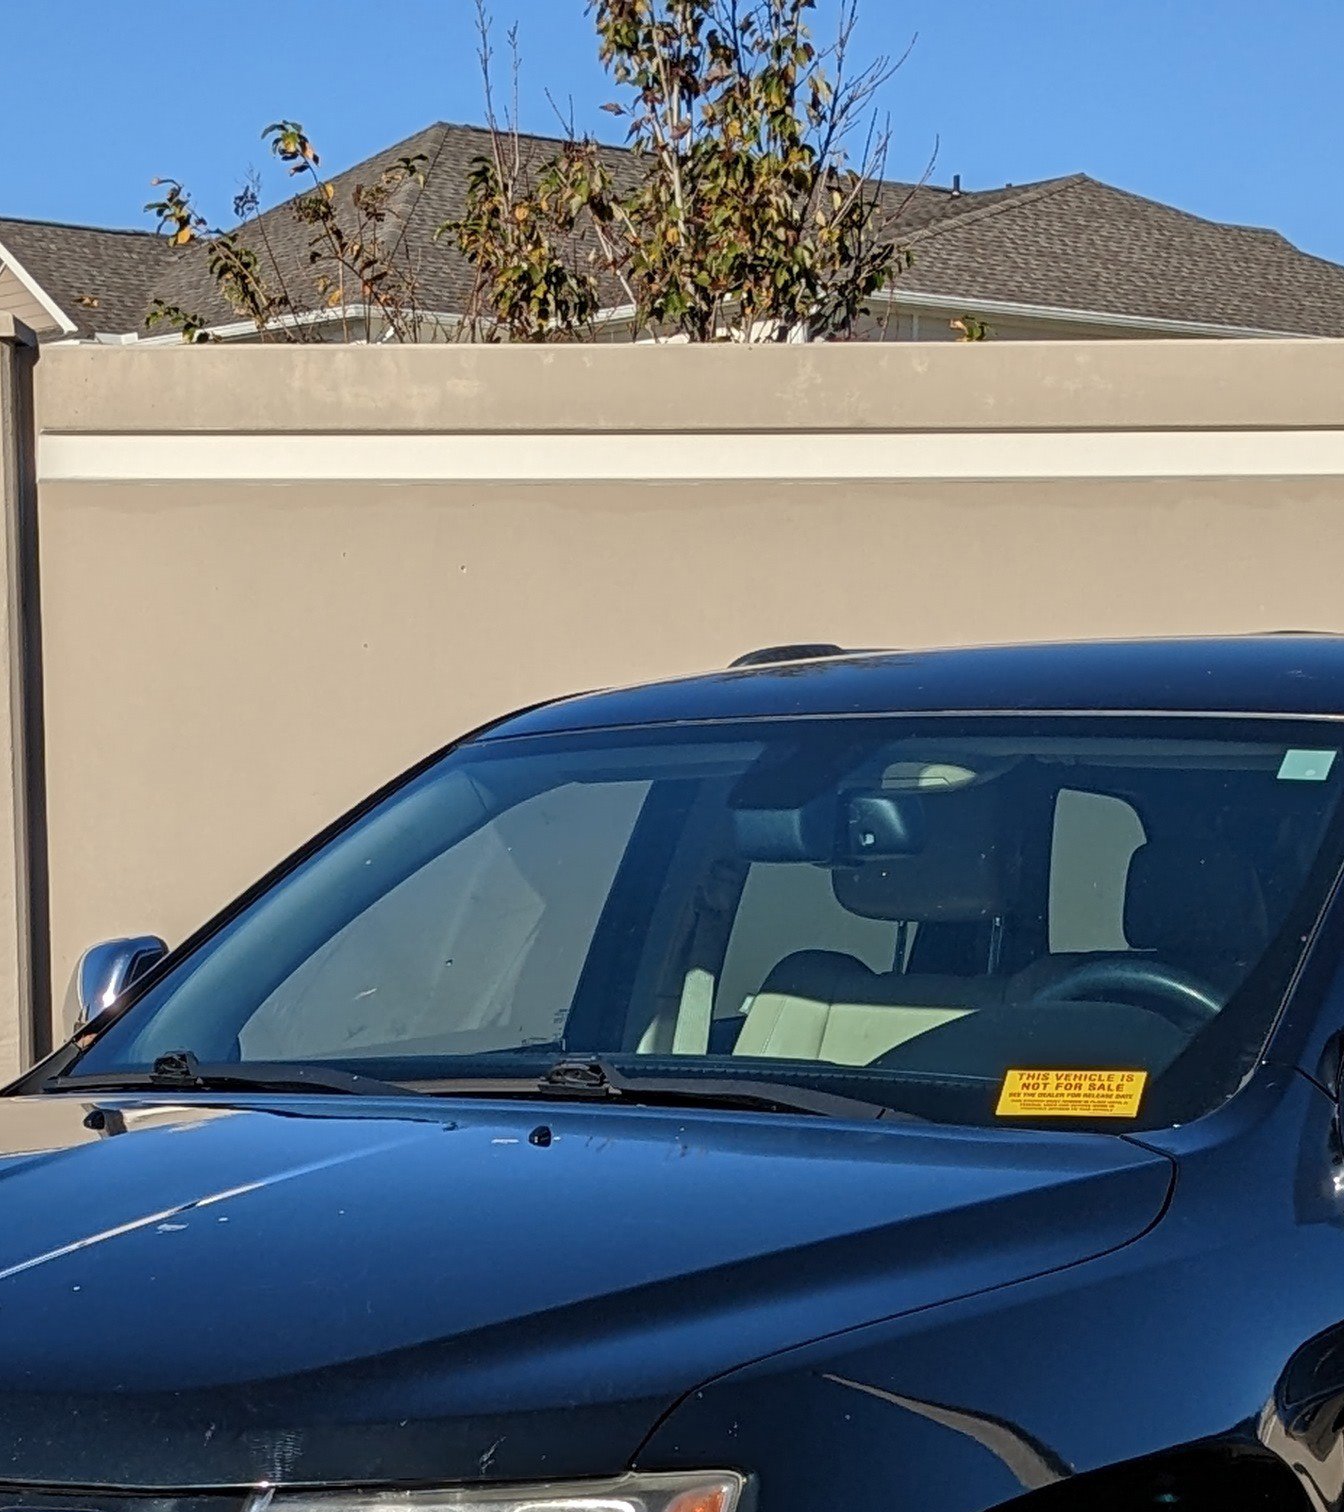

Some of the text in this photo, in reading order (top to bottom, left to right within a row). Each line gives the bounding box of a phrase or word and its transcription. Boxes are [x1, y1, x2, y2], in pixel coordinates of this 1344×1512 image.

[1018, 1073, 1134, 1082] THIS VEHICLE IS
[1021, 1082, 1125, 1092] NOT FOR SALE
